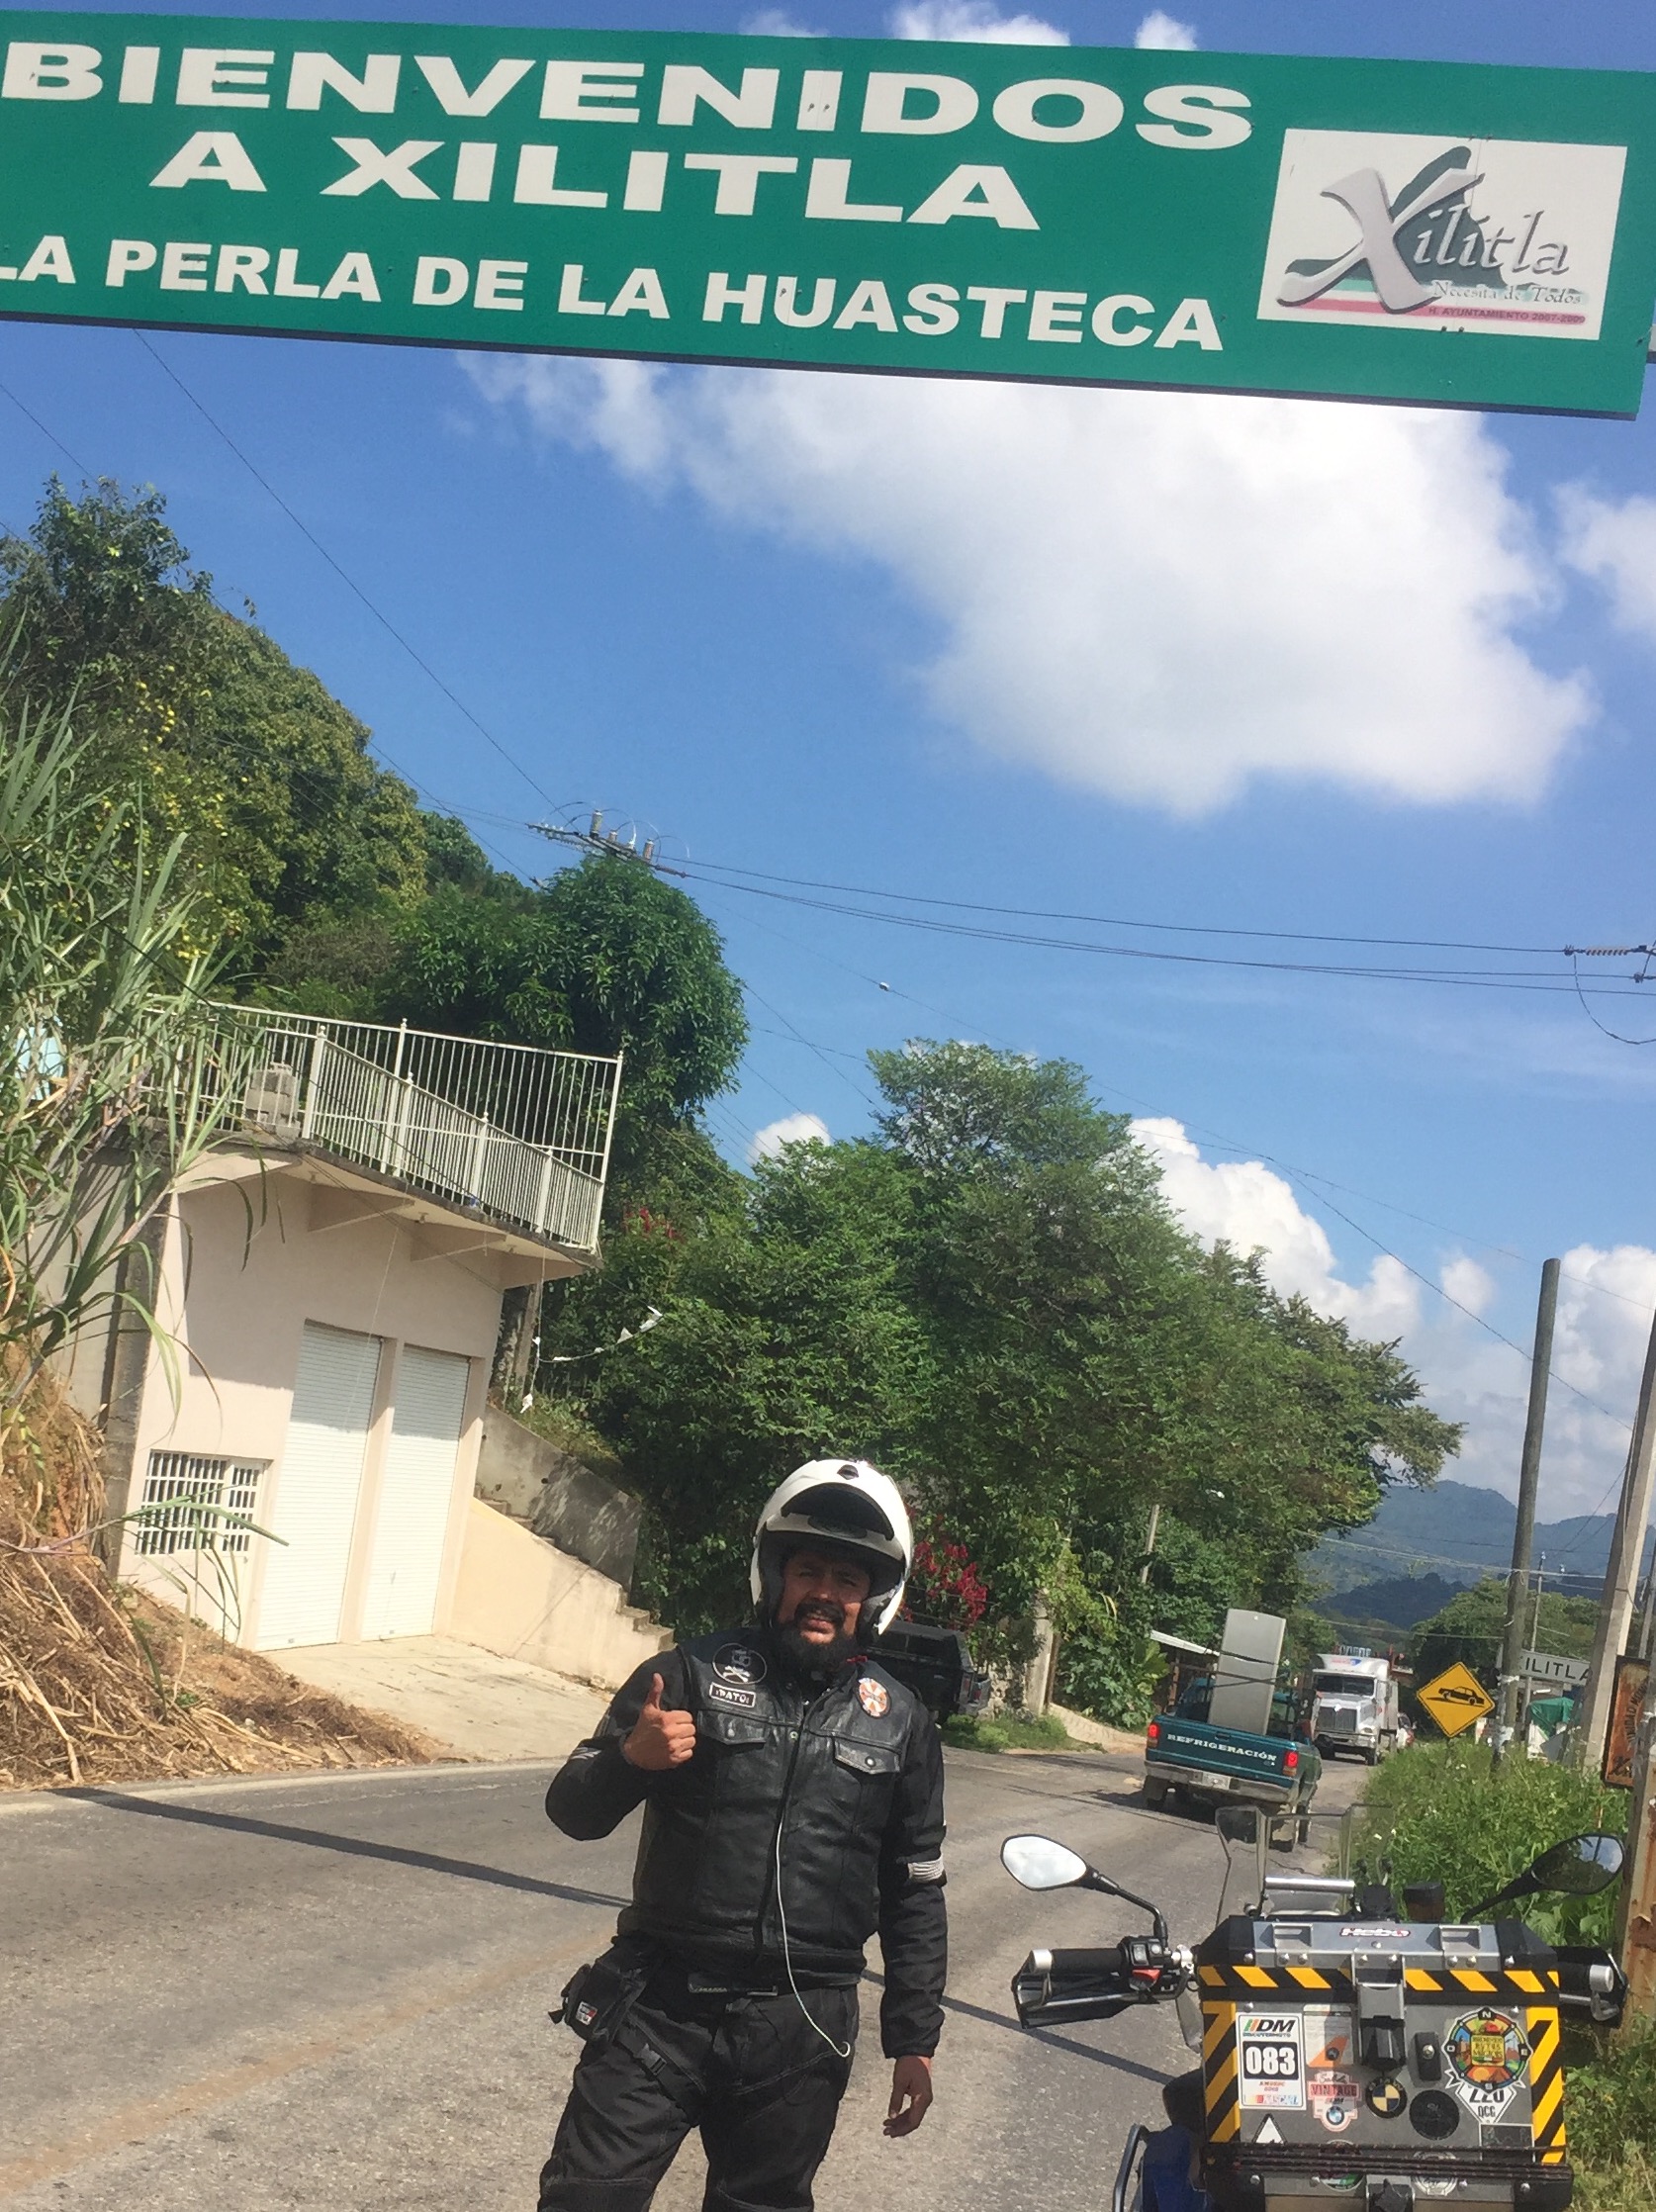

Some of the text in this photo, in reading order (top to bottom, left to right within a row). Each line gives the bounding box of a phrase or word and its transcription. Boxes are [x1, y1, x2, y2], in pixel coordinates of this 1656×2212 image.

[1, 41, 1253, 150] BIENVENIDOS
[148, 131, 1041, 231] A XILITLA
[105, 238, 382, 303] PERLA
[412, 255, 528, 311] DE
[558, 263, 670, 320] LA
[702, 271, 1224, 351] HUASTECA
[1433, 281, 1582, 304] Necesita de Todos
[1441, 308, 1529, 321] AYUNTAMIENTO
[1519, 1656, 1590, 1682] ILITLA
[1167, 1733, 1277, 1762] REFRIGERACIÓN
[1245, 2046, 1296, 2075] 083
[1312, 2084, 1357, 2096] VINTAGE
